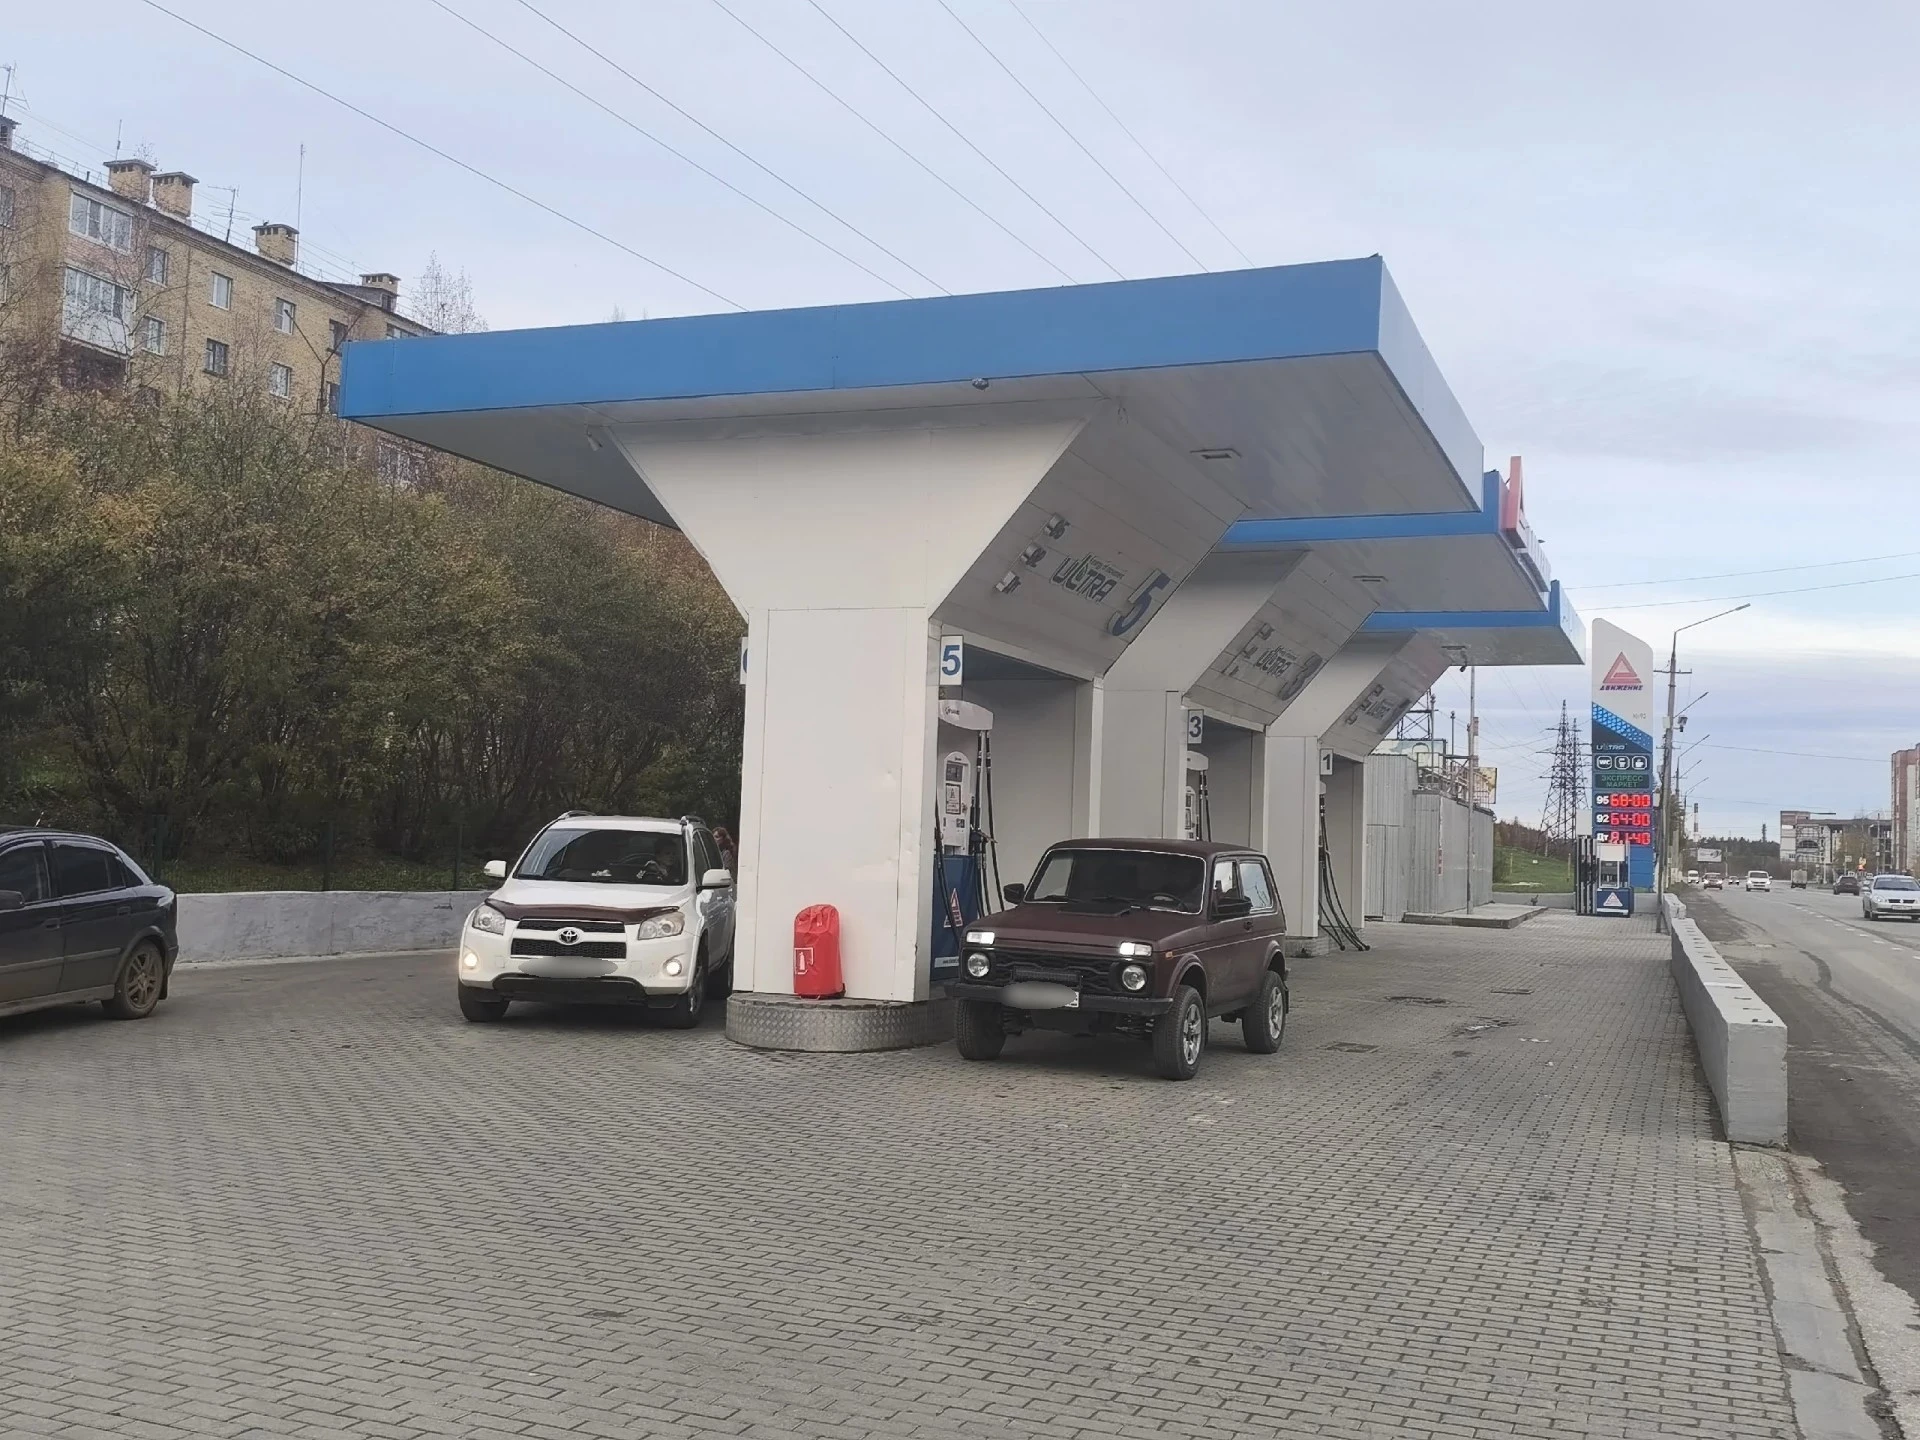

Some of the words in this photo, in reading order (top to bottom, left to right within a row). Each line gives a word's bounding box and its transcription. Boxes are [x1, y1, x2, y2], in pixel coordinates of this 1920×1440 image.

[1108, 568, 1171, 636] 5
[942, 645, 961, 676] 5
[1190, 716, 1201, 737] 3
[1323, 754, 1330, 770] 1
[1596, 796, 1609, 805] 95
[1596, 814, 1609, 823] 92
